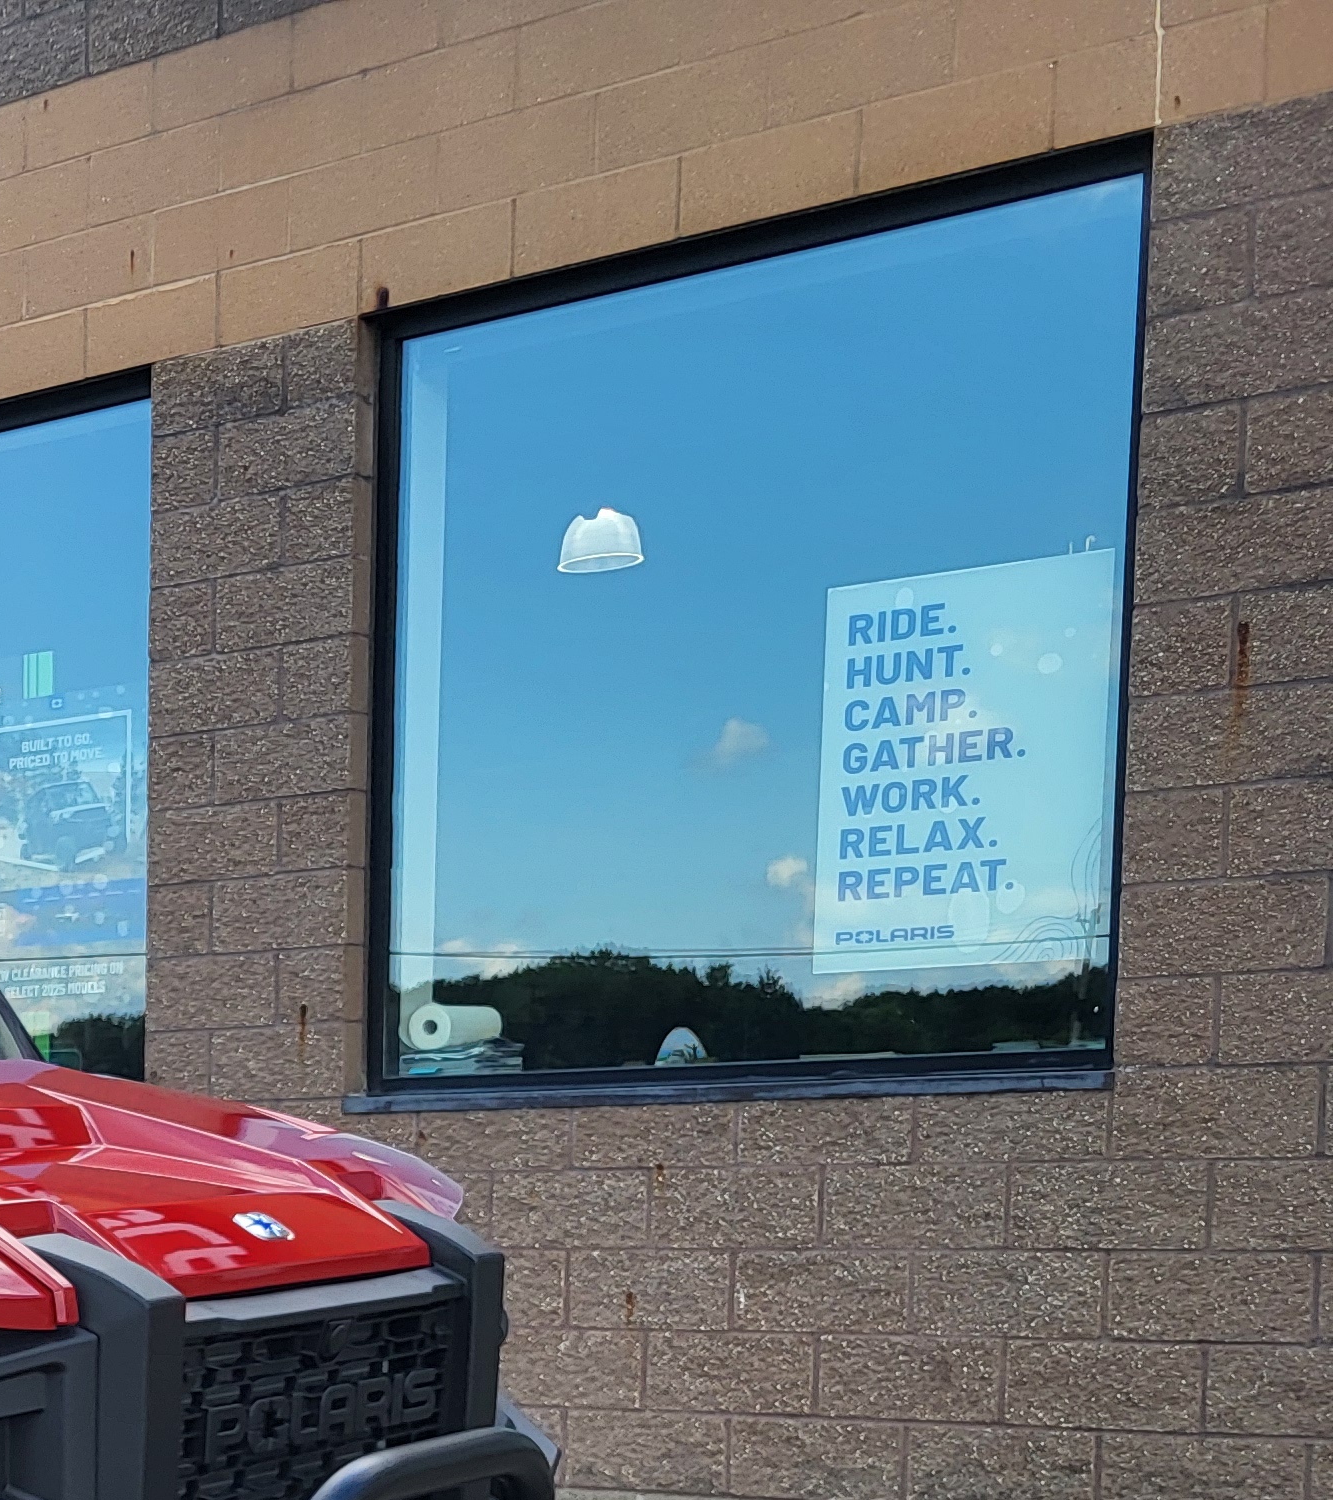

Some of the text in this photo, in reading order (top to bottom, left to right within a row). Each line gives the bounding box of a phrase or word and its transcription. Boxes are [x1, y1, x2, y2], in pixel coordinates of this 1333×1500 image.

[847, 602, 957, 647] RIDE.
[845, 644, 971, 690] HUNT.
[843, 688, 978, 732] CAMP.
[8, 752, 51, 770] PRICED
[53, 751, 69, 764] TO
[21, 732, 94, 753] BUILT TO GO.
[842, 727, 1026, 775] GATHER.
[840, 774, 981, 817] WORK.
[838, 816, 998, 860] RELAX.
[836, 858, 1014, 902] REPEAT.
[834, 925, 955, 946] POLARIS
[11, 965, 68, 982] CLEARANCE
[69, 962, 107, 978] PRICING
[109, 961, 124, 975] ON
[67, 980, 106, 995] MODELS
[202, 1367, 437, 1464] POLARIS
